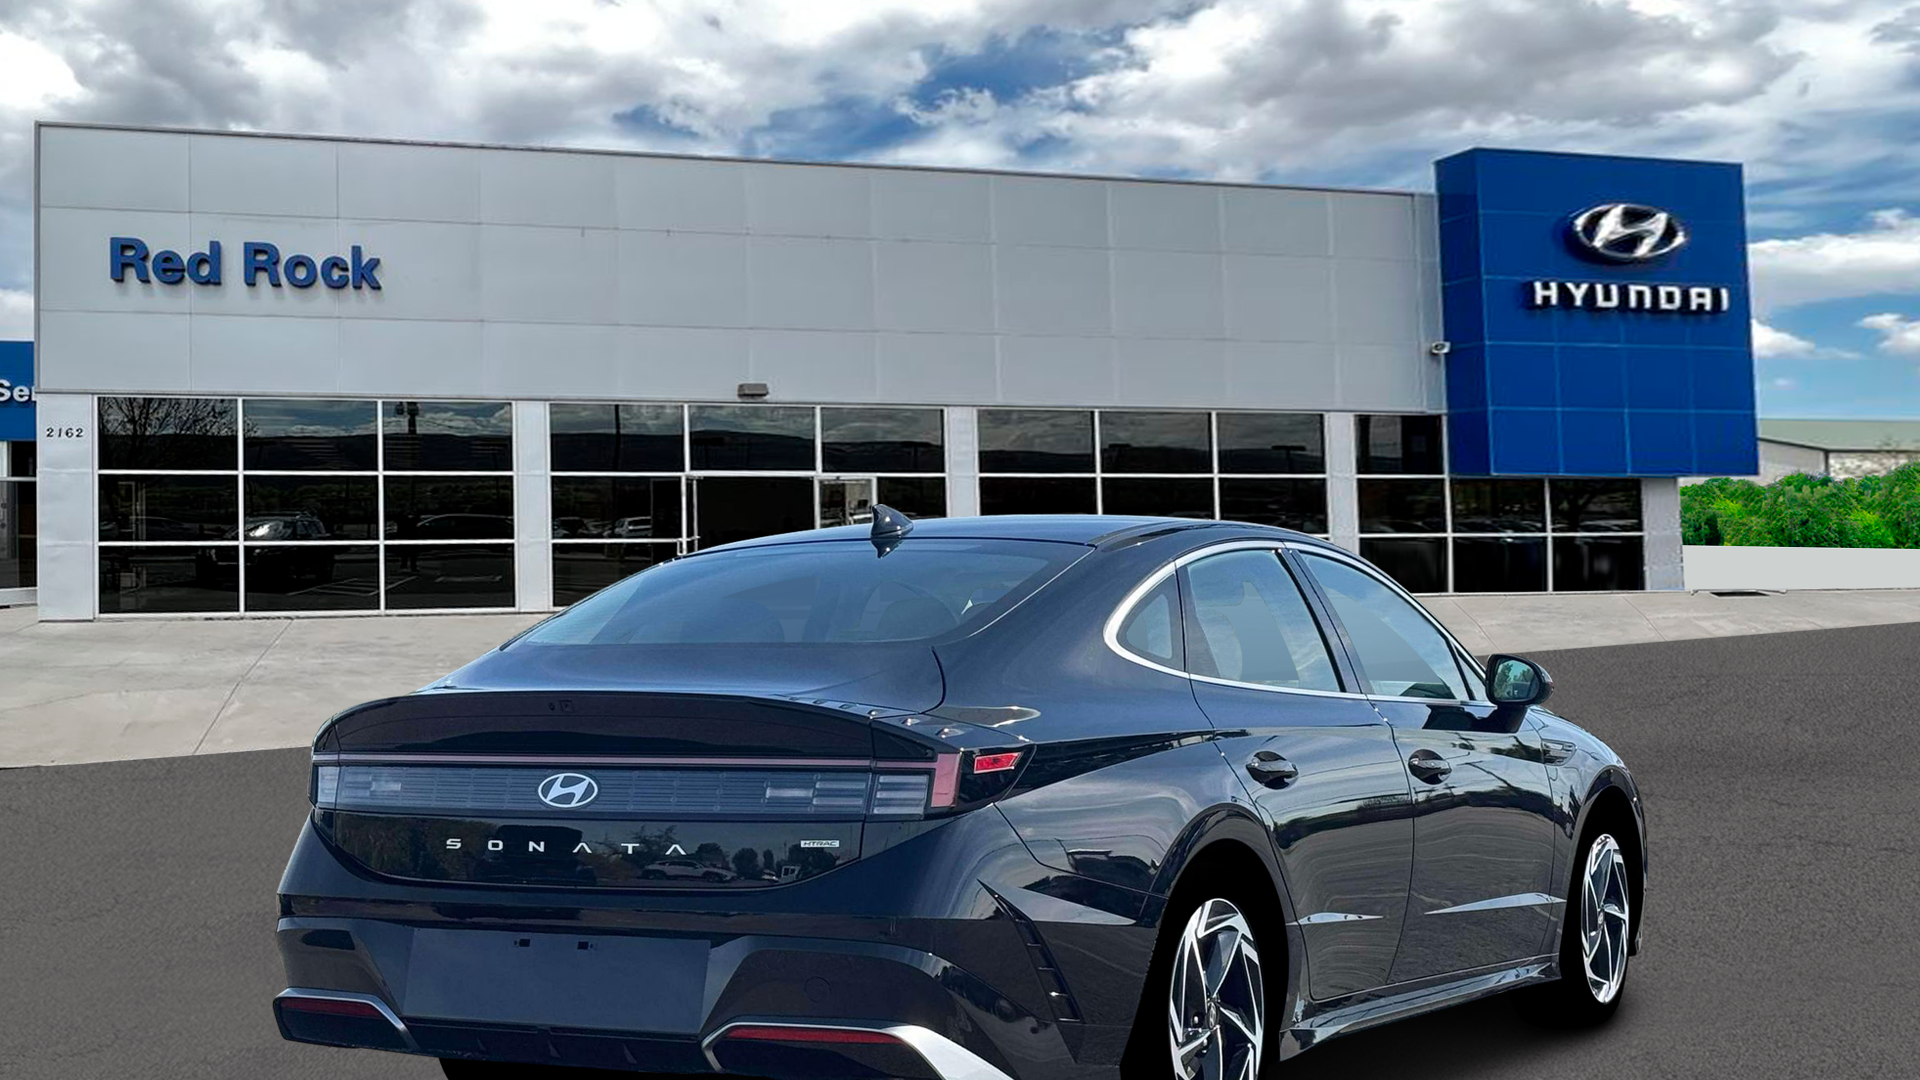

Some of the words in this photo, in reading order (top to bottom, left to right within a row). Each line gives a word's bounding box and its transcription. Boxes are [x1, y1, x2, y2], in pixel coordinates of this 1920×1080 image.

[109, 236, 222, 285] Red
[243, 241, 382, 290] Rock
[1533, 280, 1730, 312] HYUNDAI
[46, 427, 84, 438] 2162
[445, 838, 687, 856] SONATA
